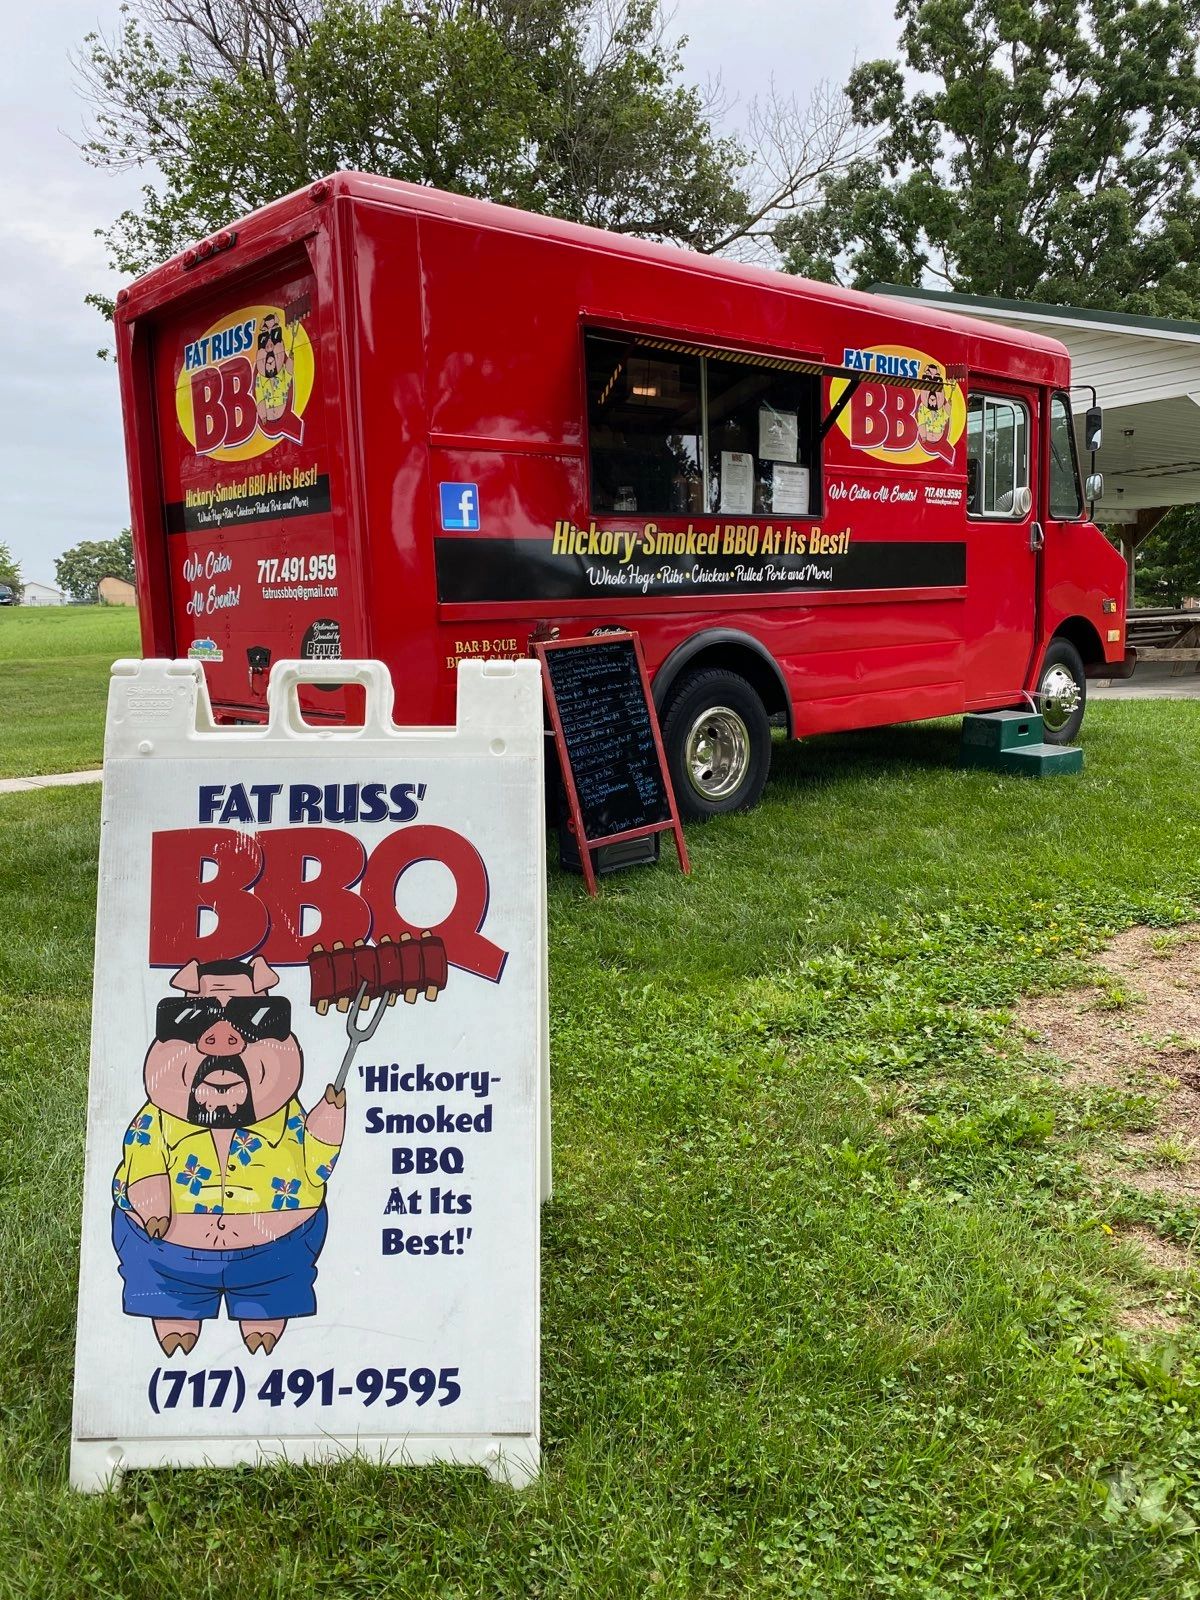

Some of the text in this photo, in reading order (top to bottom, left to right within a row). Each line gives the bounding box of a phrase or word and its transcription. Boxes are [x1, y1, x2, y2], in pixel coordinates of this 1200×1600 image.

[184, 319, 256, 372] FAT RUSS'
[843, 348, 921, 378] FAT RUSS'
[190, 355, 304, 456] BBQ
[850, 382, 956, 465] BBQ
[185, 463, 318, 509] Hickory-Smoked BBQ At Its Best!
[829, 481, 918, 503] We Cater All Events!
[924, 487, 962, 499] 717.491.9595
[552, 521, 850, 563] Hickory-Smoked BBQ At Its Best!
[183, 551, 232, 582] We Cater
[586, 563, 833, 593] Whole Hogs Ribs Chicken Pulled Pork and More!
[186, 584, 241, 617] All Events!
[307, 641, 341, 656] BEAVER
[199, 782, 427, 824] FAT RUSS'
[608, 818, 631, 833] Thank
[149, 824, 509, 984] BBQ
[365, 1104, 492, 1134] Smoked
[392, 1146, 464, 1174] BBQ
[383, 1186, 472, 1215] At Its
[382, 1227, 472, 1256] Best!'
[148, 1366, 462, 1414] (717) 491-9595
